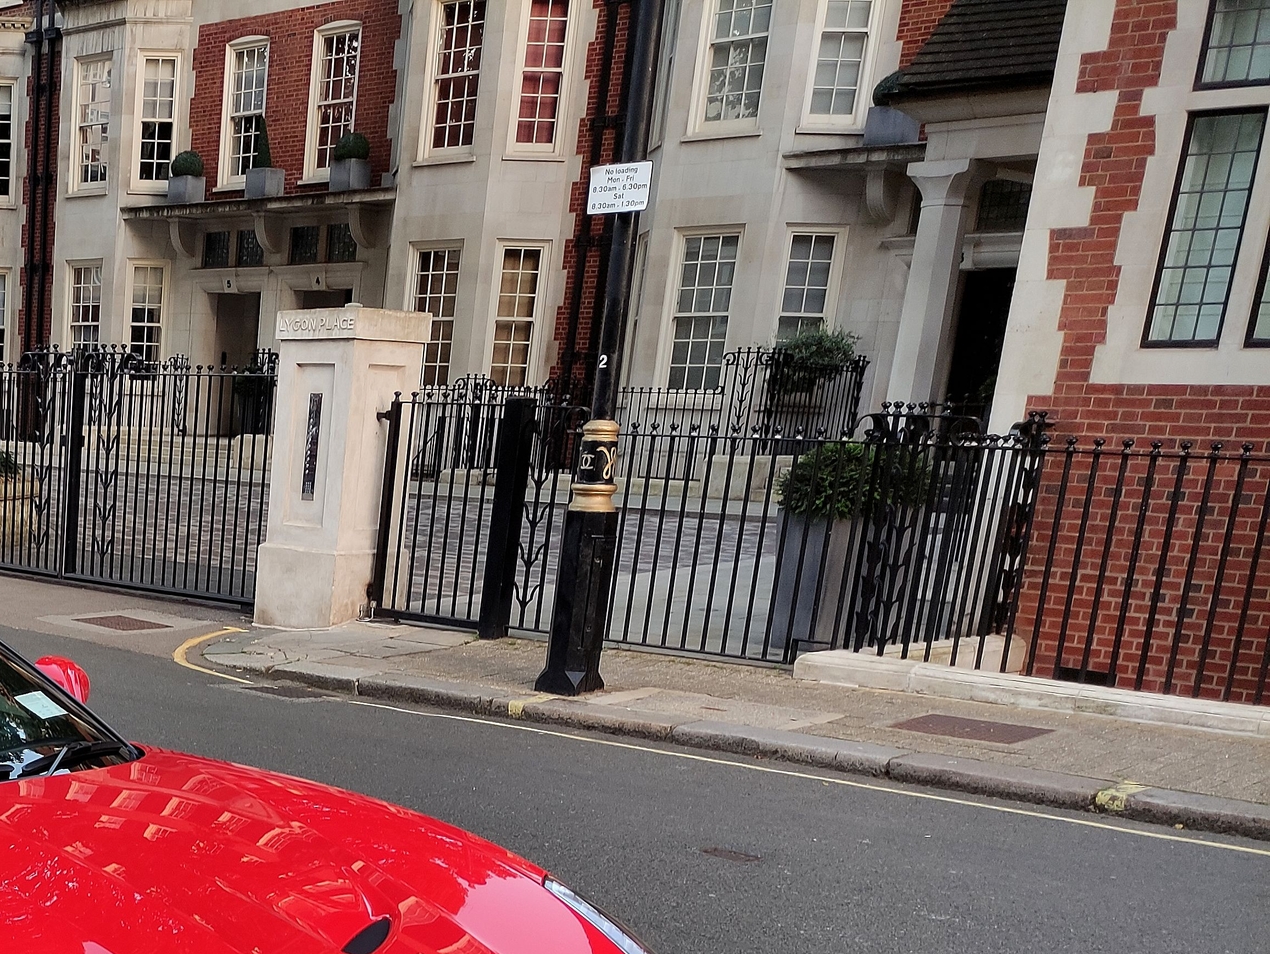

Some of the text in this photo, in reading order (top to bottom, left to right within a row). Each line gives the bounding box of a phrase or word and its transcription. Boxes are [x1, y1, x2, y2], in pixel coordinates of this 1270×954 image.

[226, 280, 232, 288] 5
[316, 276, 320, 286] 4
[279, 316, 355, 332] LYGON PLACE
[598, 355, 608, 368] 2
